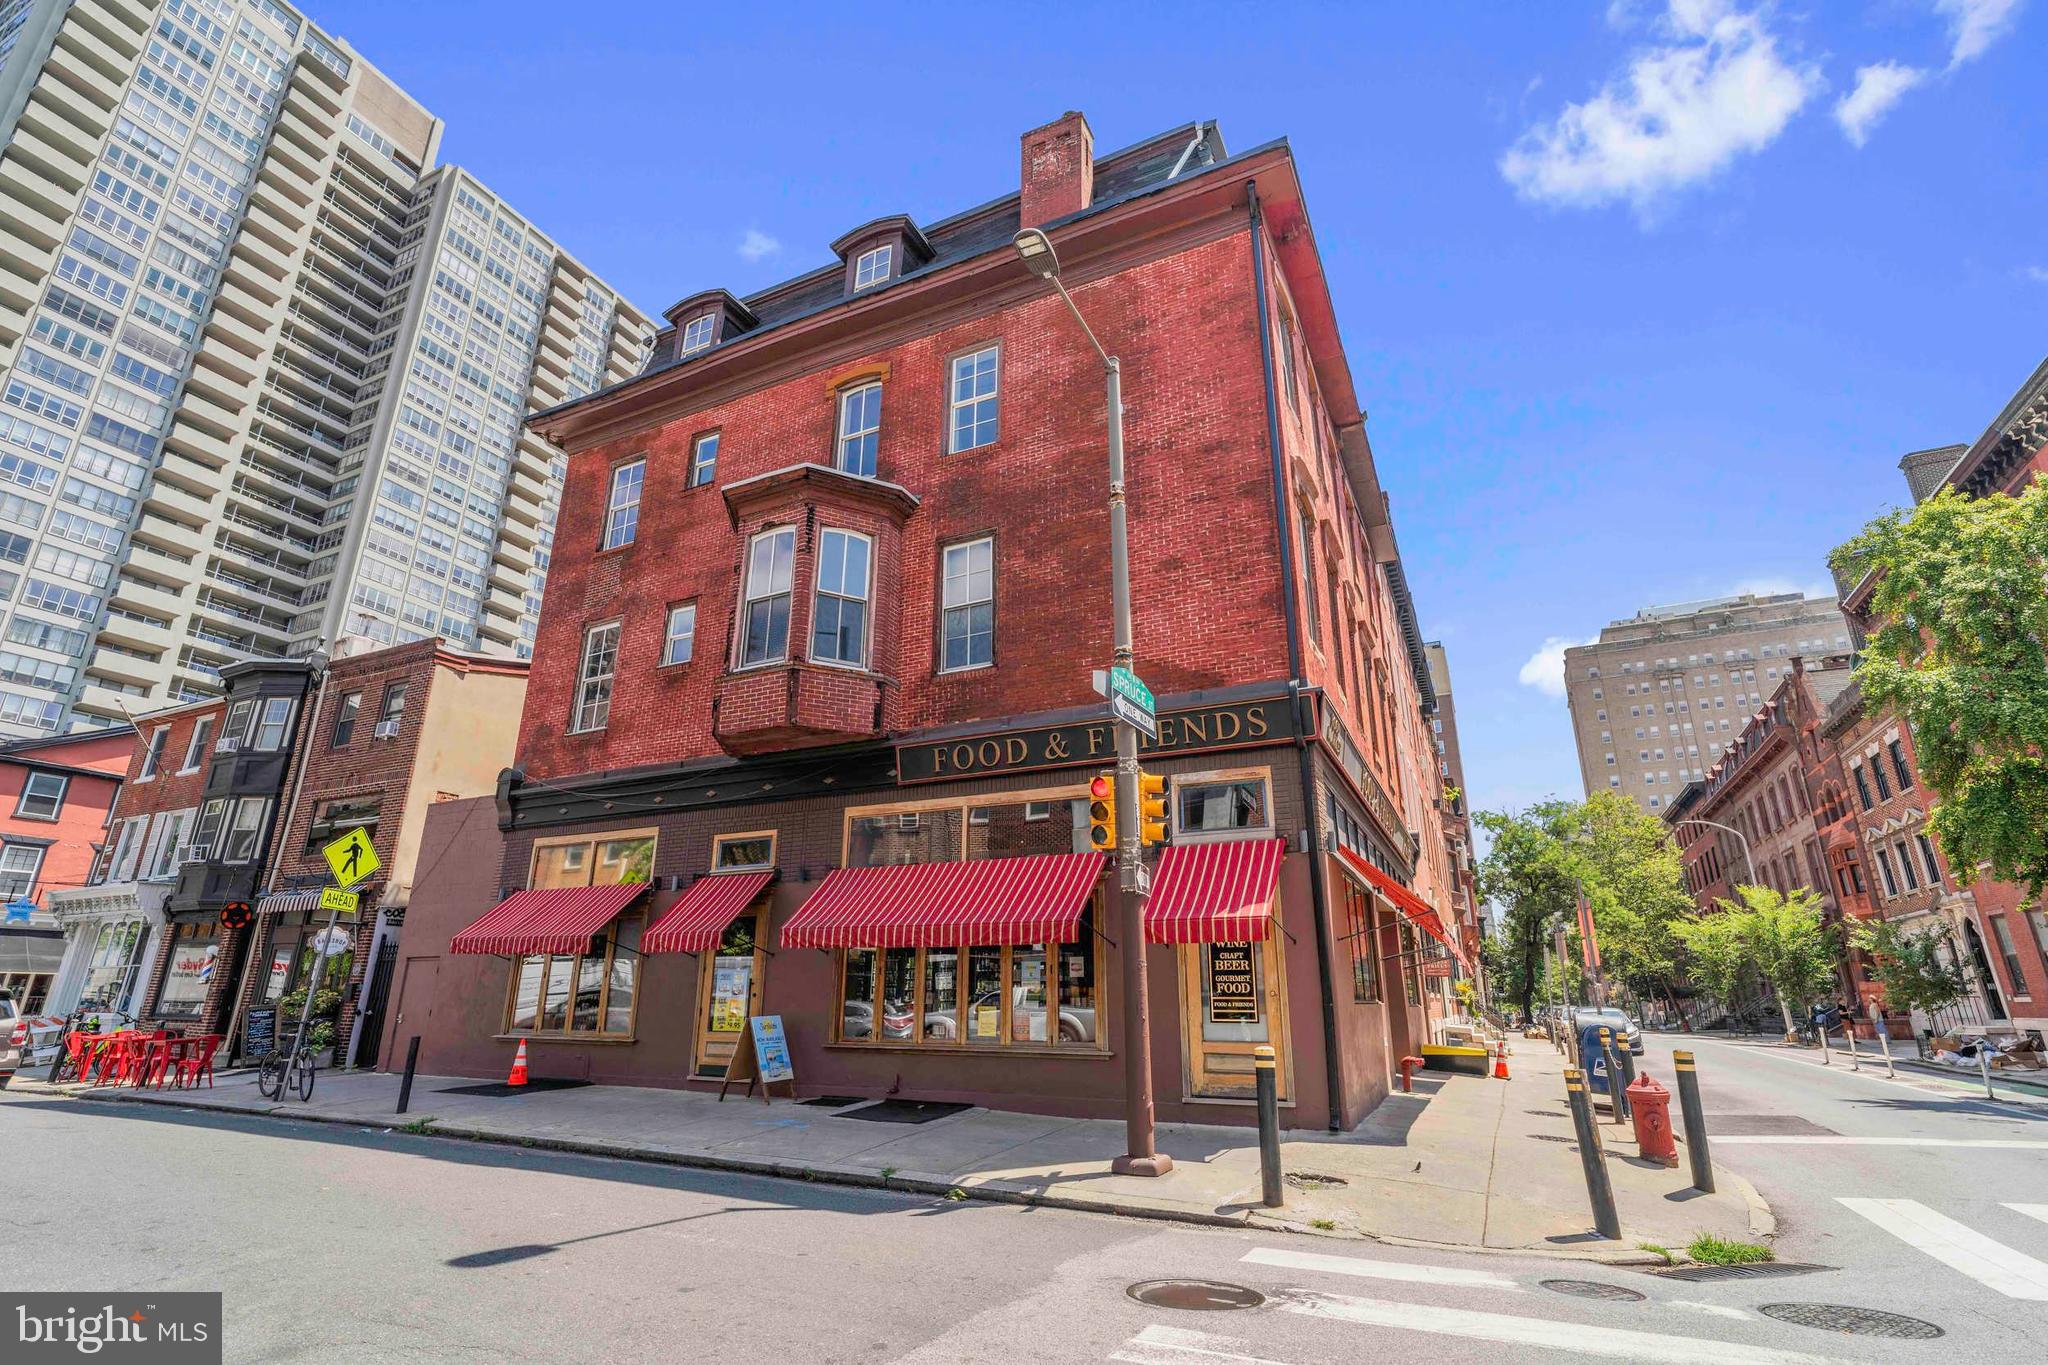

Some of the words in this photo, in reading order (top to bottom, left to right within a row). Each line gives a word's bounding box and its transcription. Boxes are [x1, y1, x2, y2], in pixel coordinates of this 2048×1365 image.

[1113, 671, 1147, 708] SPRUCE
[933, 738, 1028, 772] FOOD
[1045, 732, 1071, 760] &
[325, 892, 355, 908] AHEAD
[1219, 952, 1244, 960] CRAFT
[1214, 960, 1251, 971] BEER
[1216, 983, 1251, 994] FOOD
